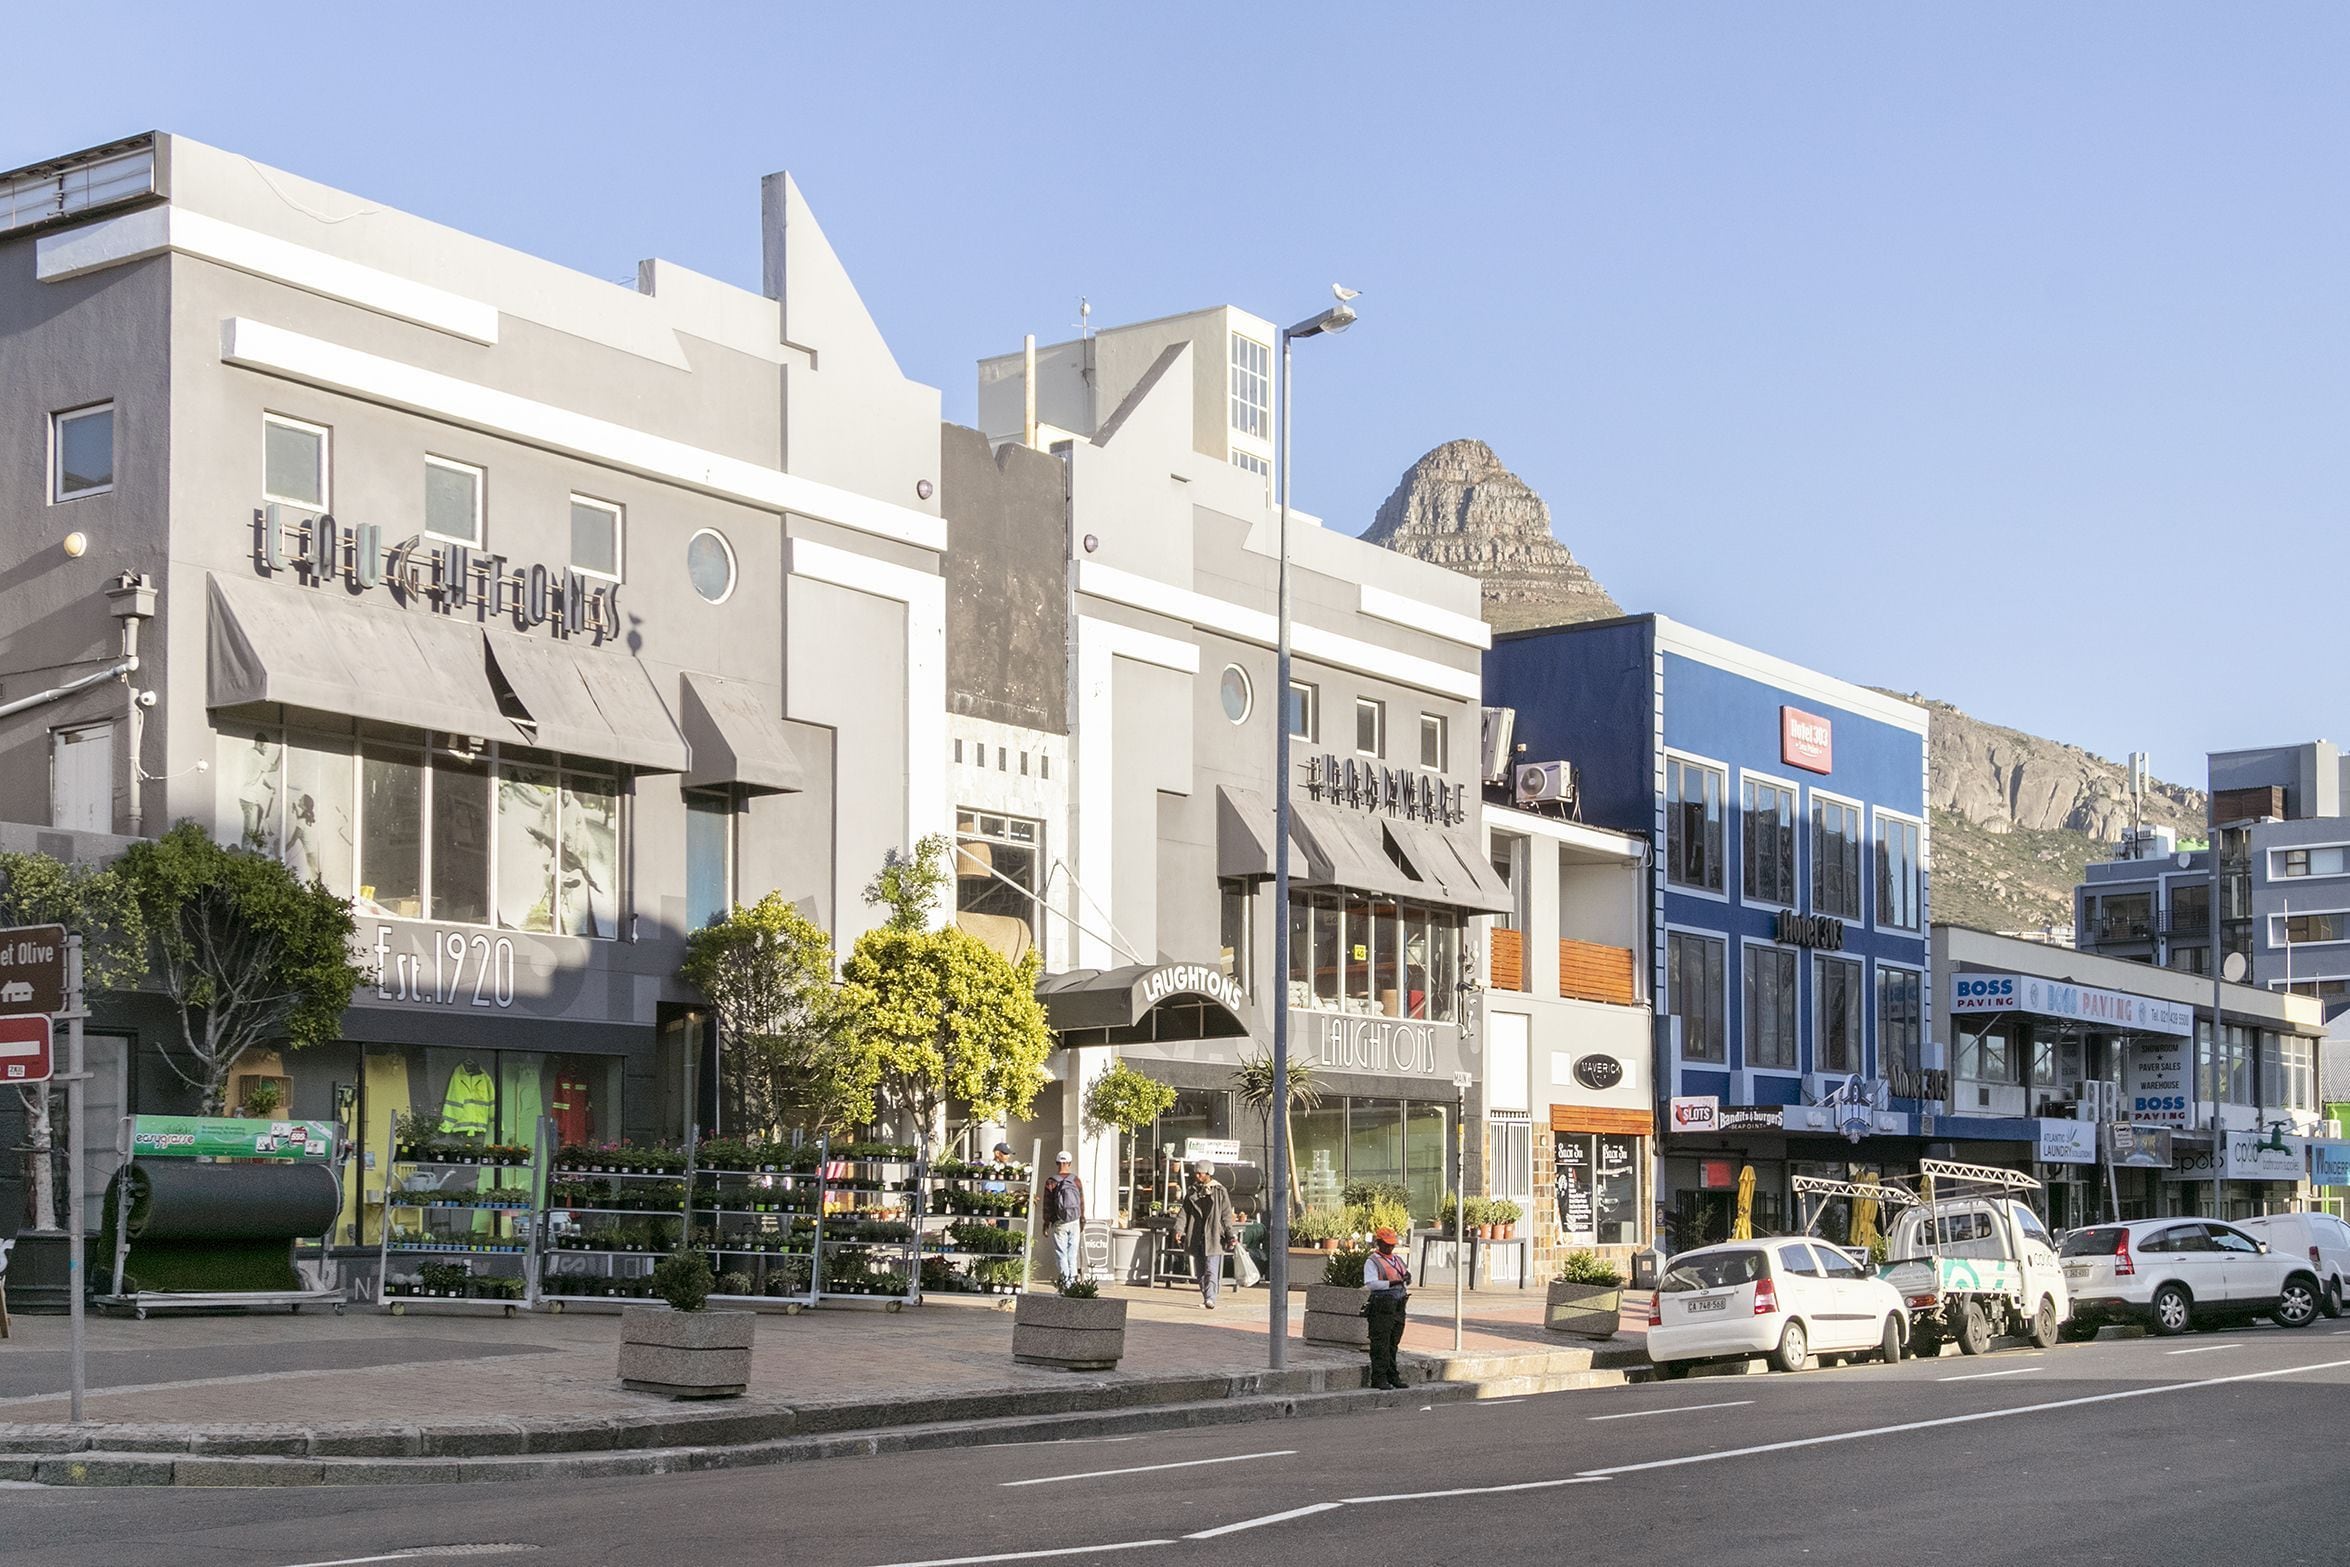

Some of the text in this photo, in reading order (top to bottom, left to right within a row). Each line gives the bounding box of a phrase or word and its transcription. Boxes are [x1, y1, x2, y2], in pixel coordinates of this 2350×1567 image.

[18, 941, 54, 966] Olive
[1142, 965, 1243, 1012] LAUGHTONS
[1957, 979, 2013, 997] BOSS
[1957, 997, 2013, 1008] PAVING
[2047, 984, 2132, 1022] BOSS PAVING
[1320, 1016, 1436, 1075] LAUGHTONS
[2138, 1062, 2182, 1072] PAVER SALES
[2140, 1080, 2180, 1091] WAREHOUSE
[2135, 1096, 2186, 1111] BOSS
[2135, 1111, 2186, 1121] PAVING
[2043, 1144, 2072, 1157] LAUNDRY
